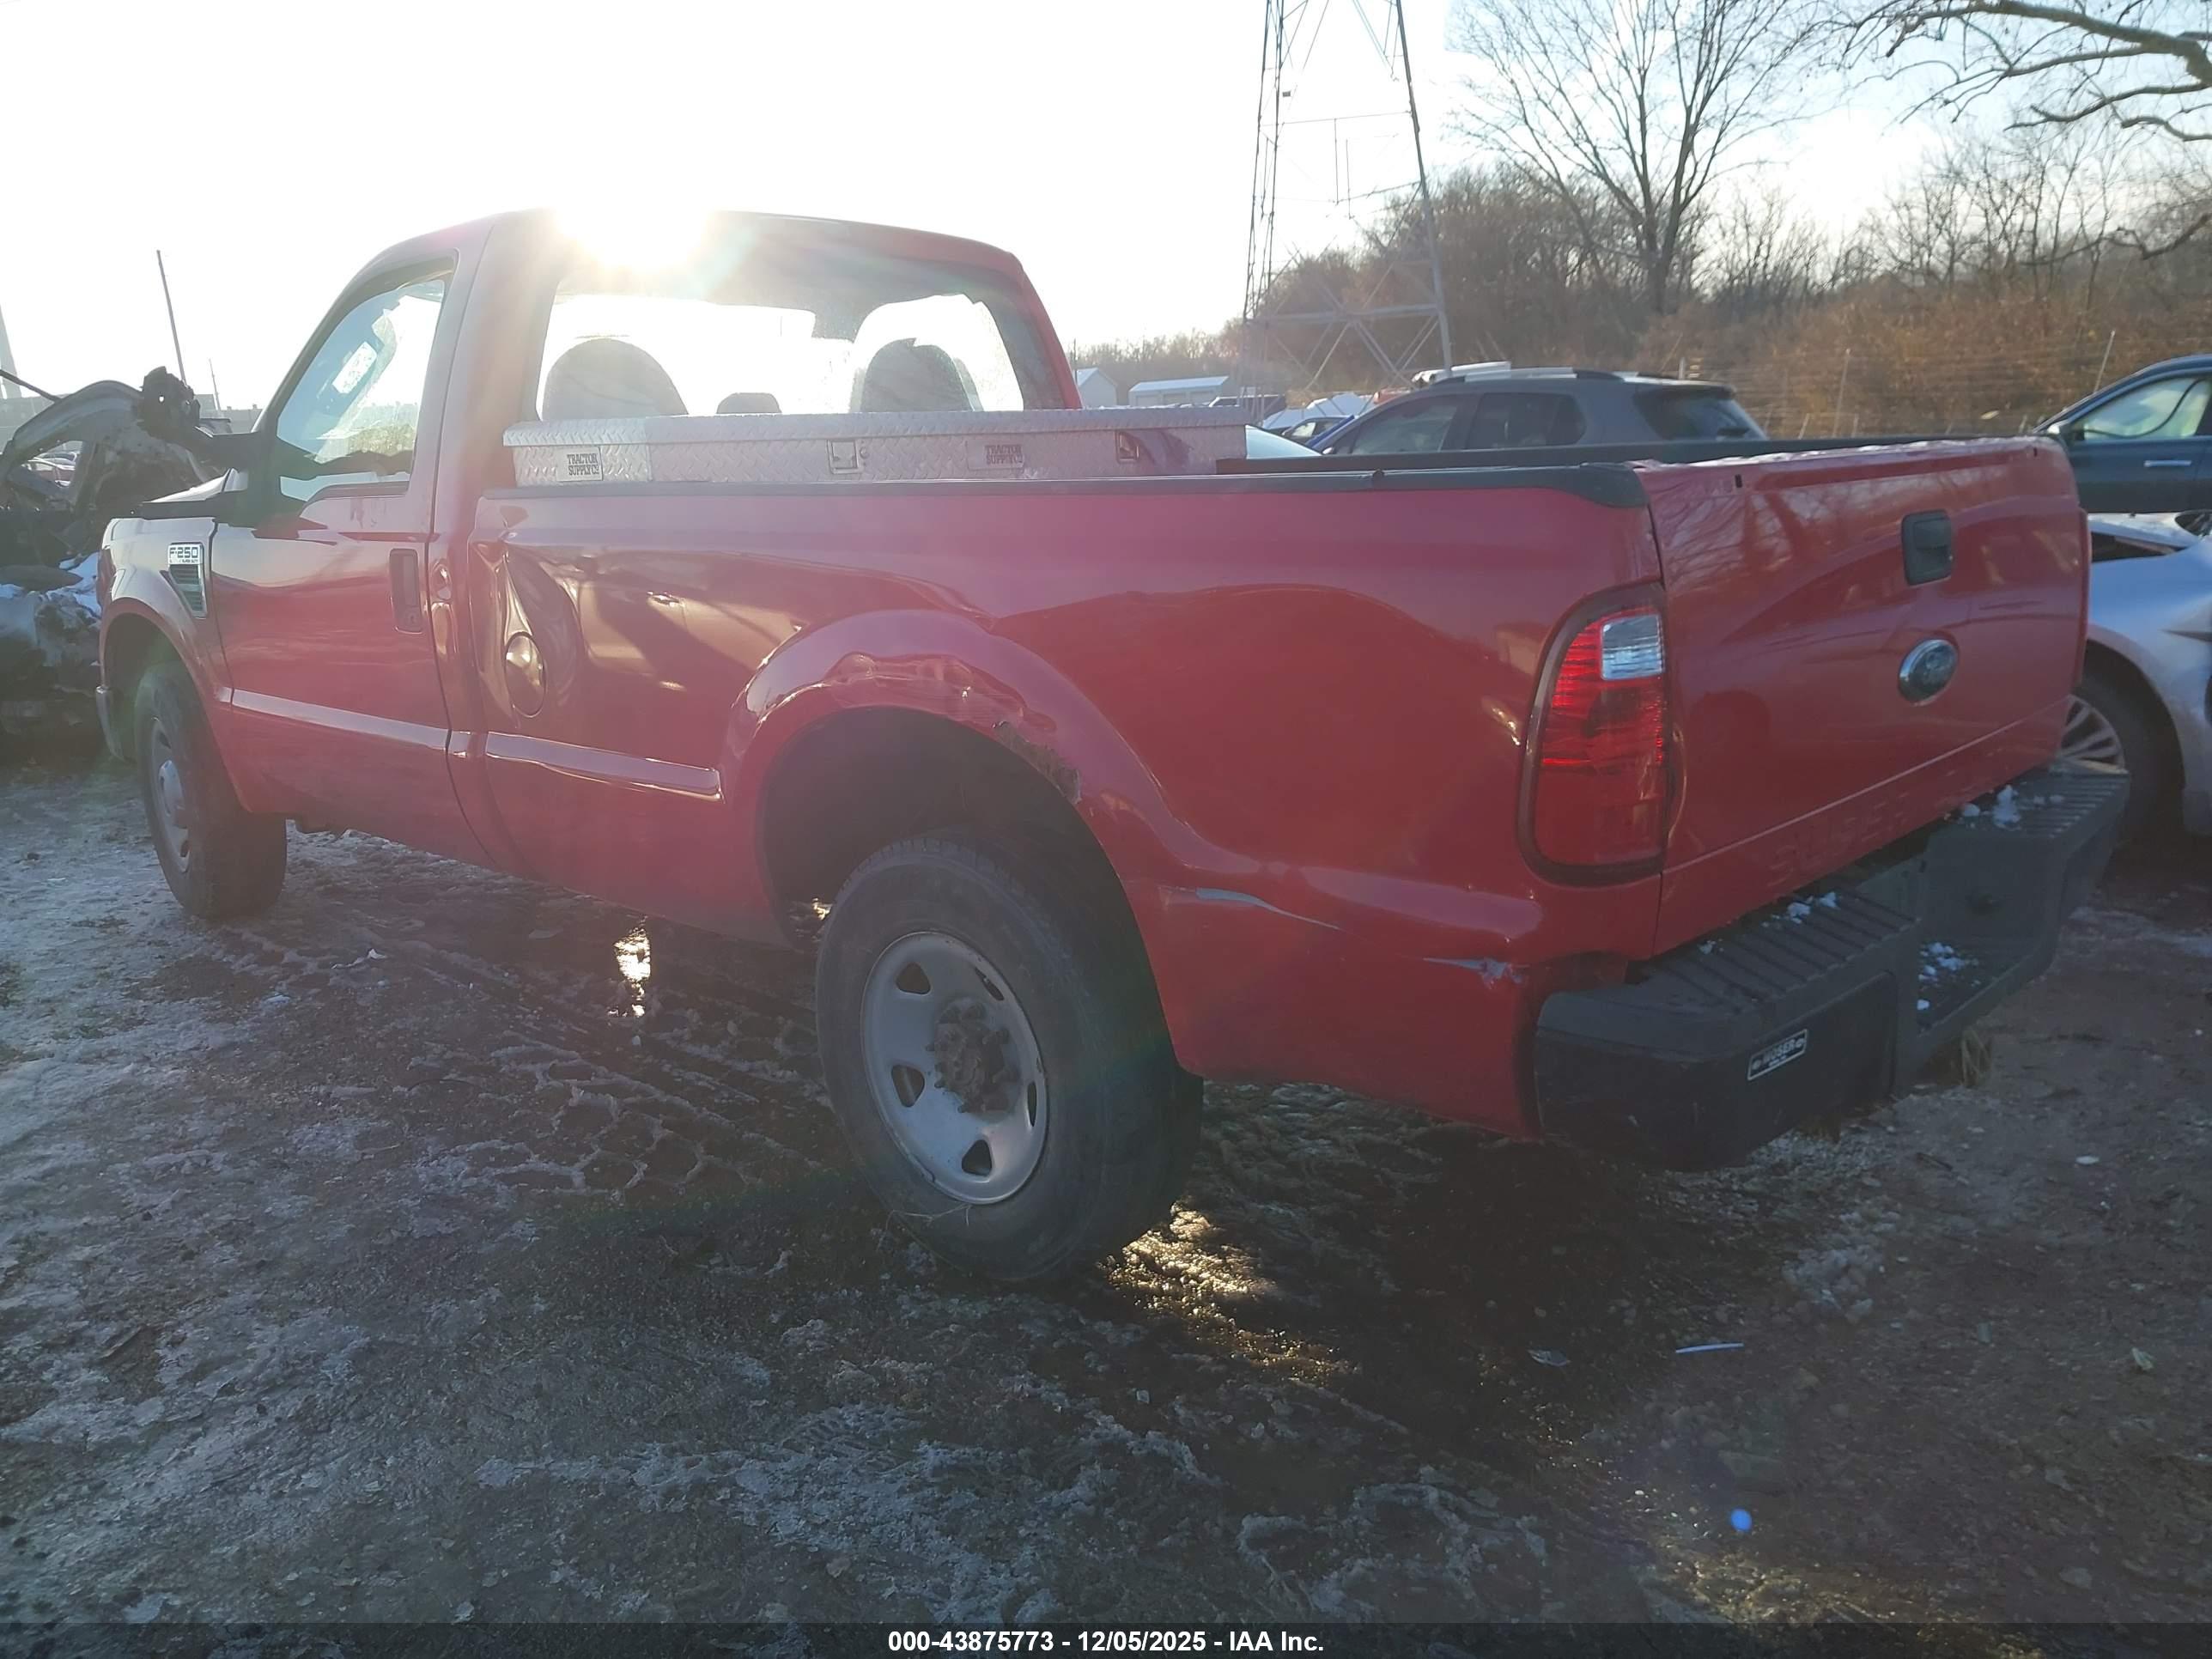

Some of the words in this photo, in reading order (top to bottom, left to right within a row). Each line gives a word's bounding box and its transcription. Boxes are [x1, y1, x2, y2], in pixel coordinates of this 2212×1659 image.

[984, 444, 1023, 454] TRACTOR
[567, 453, 599, 465] TRACTOR
[568, 465, 592, 476] SUPPLY
[169, 546, 198, 559] F-250
